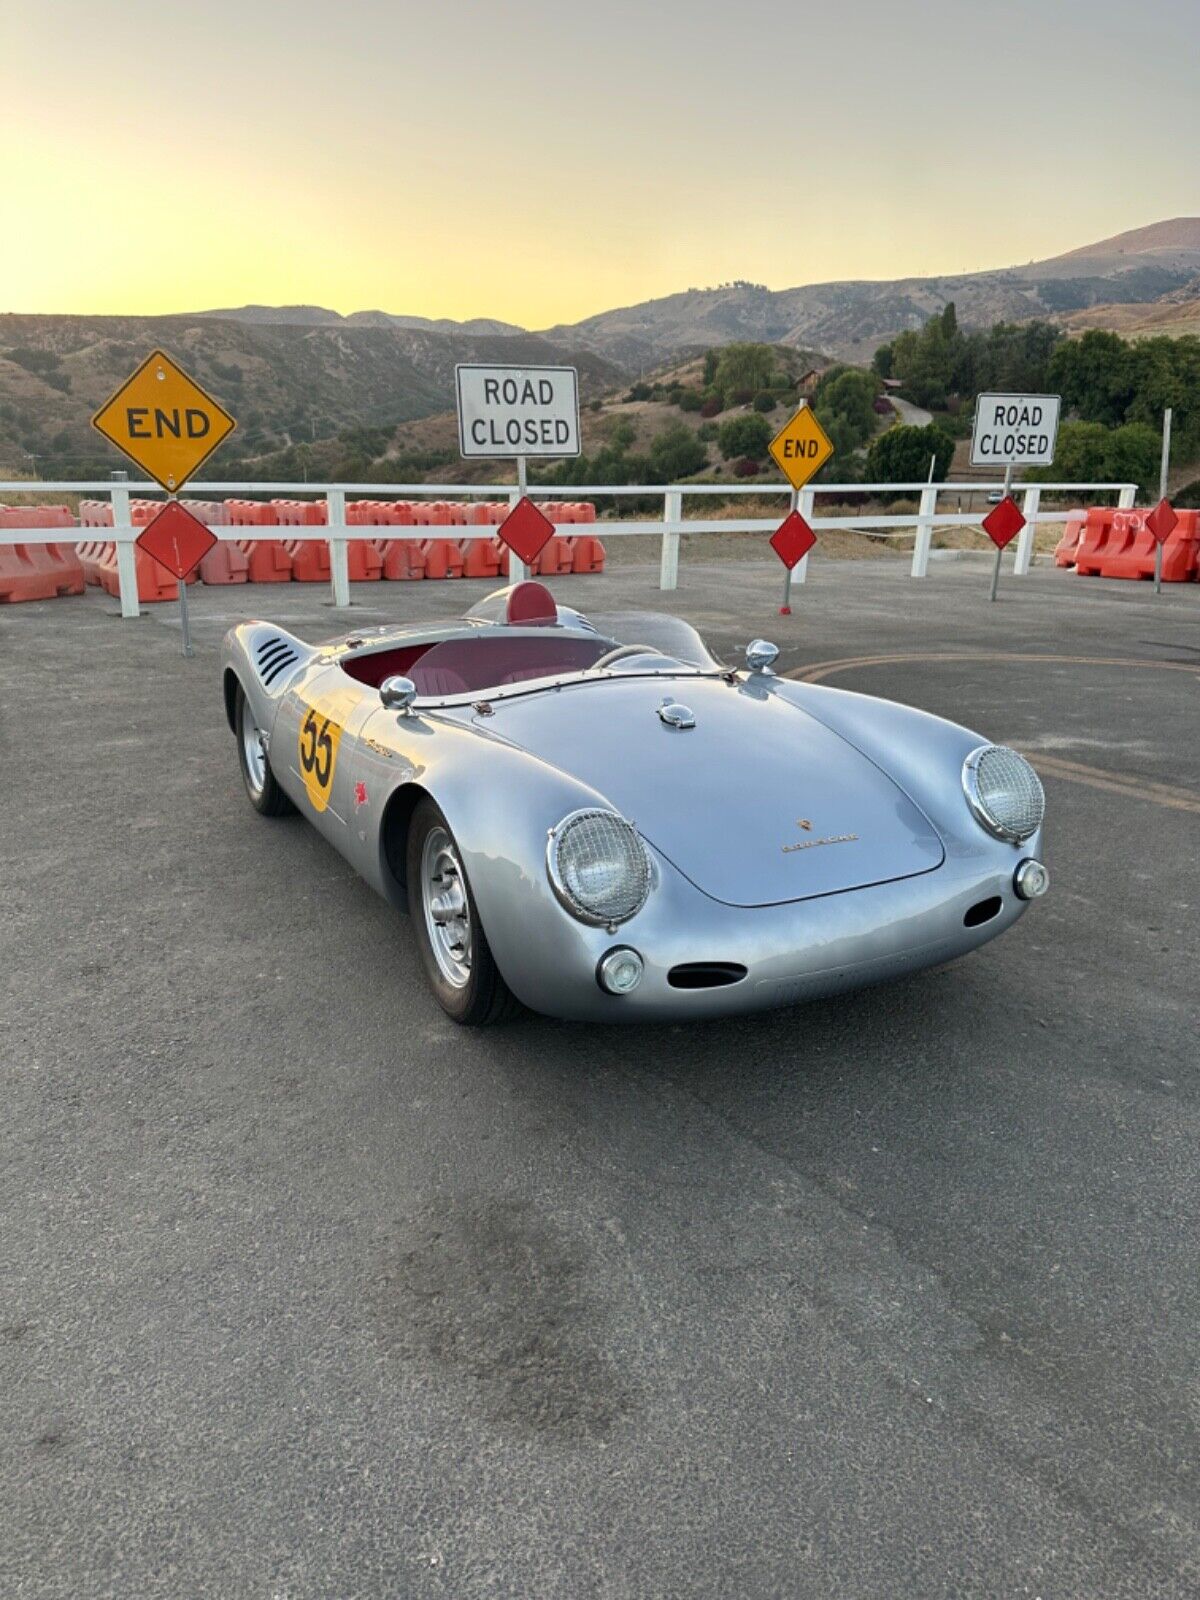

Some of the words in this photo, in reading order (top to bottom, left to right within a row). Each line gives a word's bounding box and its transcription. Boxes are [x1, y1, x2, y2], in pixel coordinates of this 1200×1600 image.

[484, 379, 553, 405] ROAD
[127, 408, 210, 438] END
[994, 406, 1042, 426] ROAD
[471, 419, 569, 445] CLOSED
[980, 434, 1049, 455] CLOSED
[783, 439, 819, 458] END
[301, 709, 340, 788] 55
